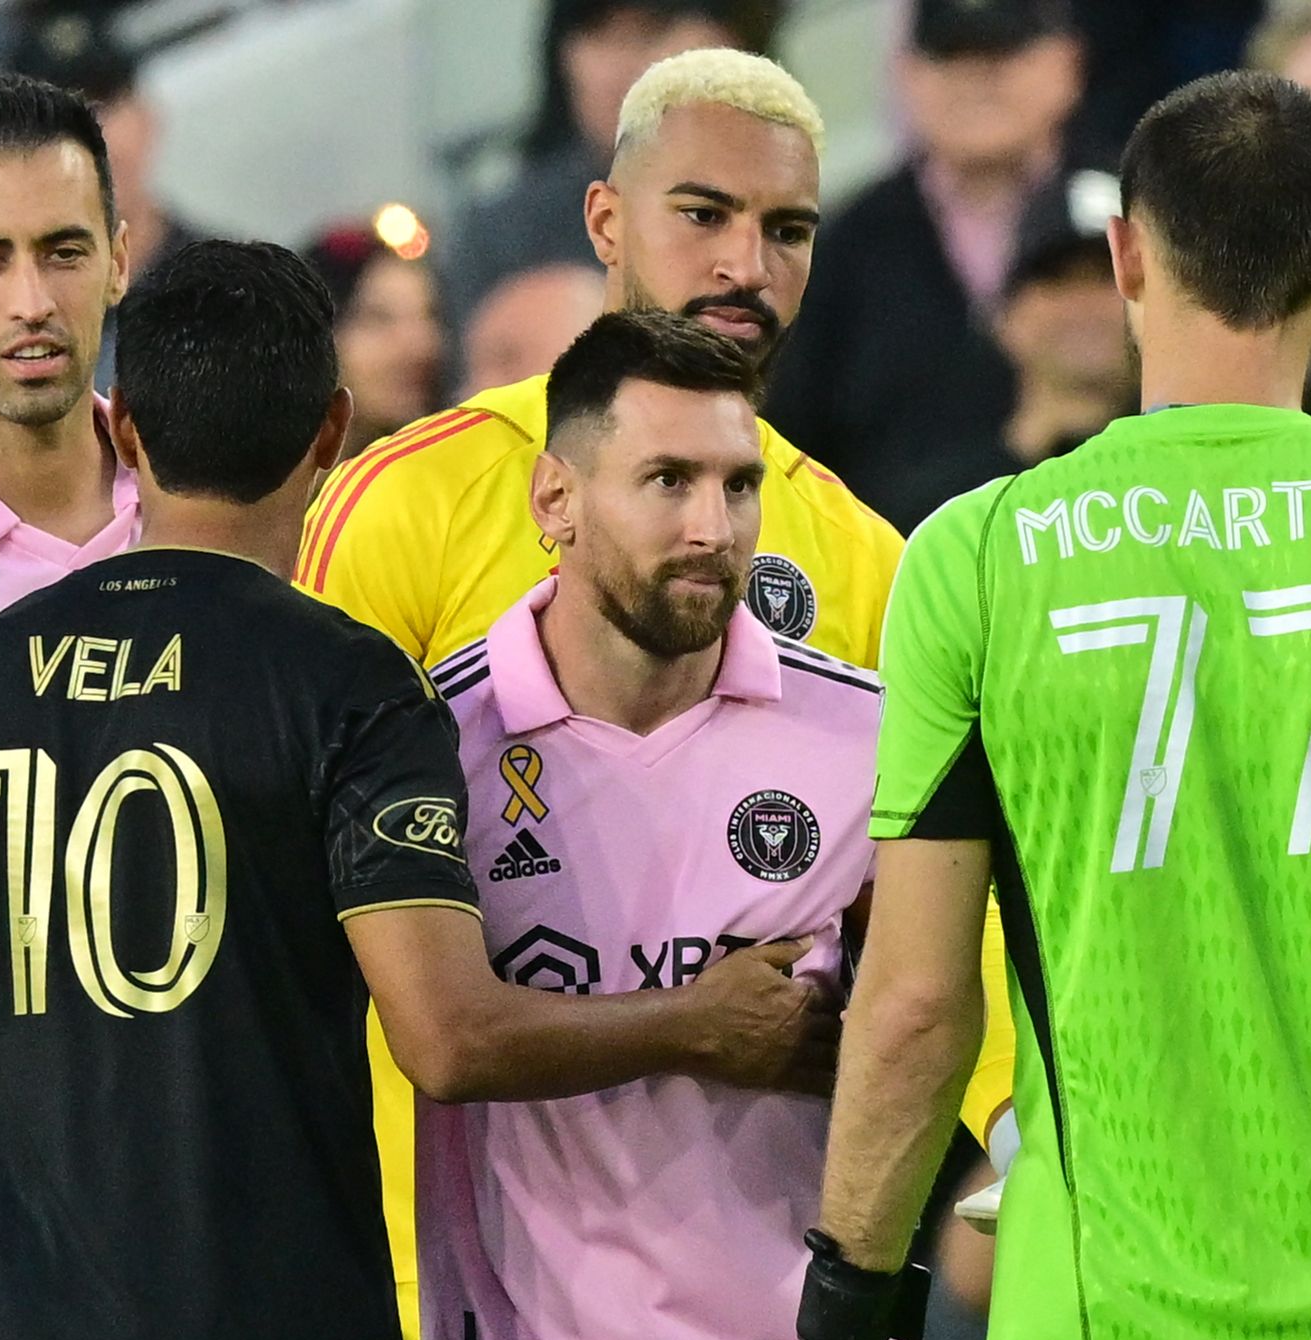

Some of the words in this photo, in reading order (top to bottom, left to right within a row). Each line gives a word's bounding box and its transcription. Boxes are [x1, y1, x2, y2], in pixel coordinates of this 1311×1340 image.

[99, 579, 122, 591] LOS
[29, 633, 182, 702] VELA
[729, 791, 802, 831] INTERNACIONAL
[755, 814, 792, 824] MIAMI
[802, 810, 814, 824] DE
[729, 834, 744, 860] CLUB
[489, 858, 562, 882] adidas
[759, 870, 791, 881] MMXX
